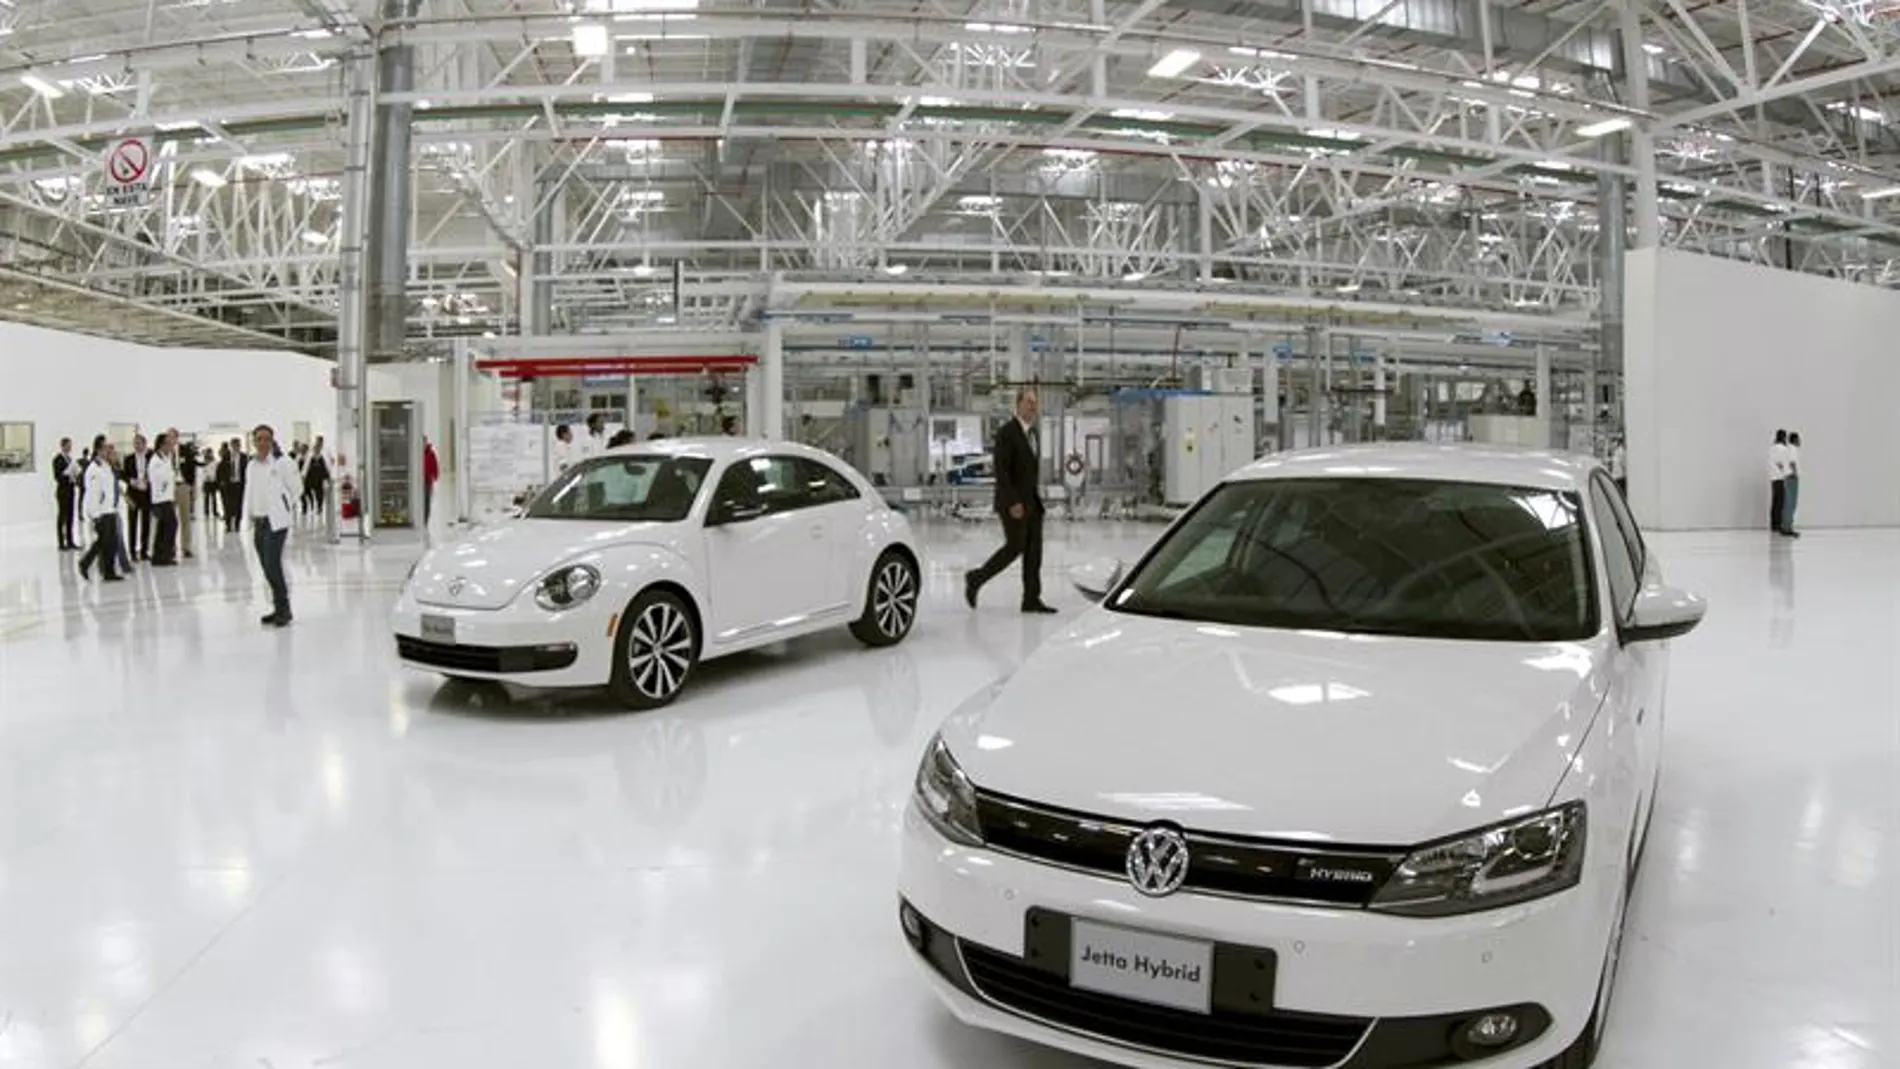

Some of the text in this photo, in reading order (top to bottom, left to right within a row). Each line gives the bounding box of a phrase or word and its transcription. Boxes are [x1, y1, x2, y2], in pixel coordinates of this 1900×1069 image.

[106, 186, 119, 195] EN
[1310, 867, 1373, 883] HYBRID
[1080, 945, 1201, 983] Jetta Hybrid
